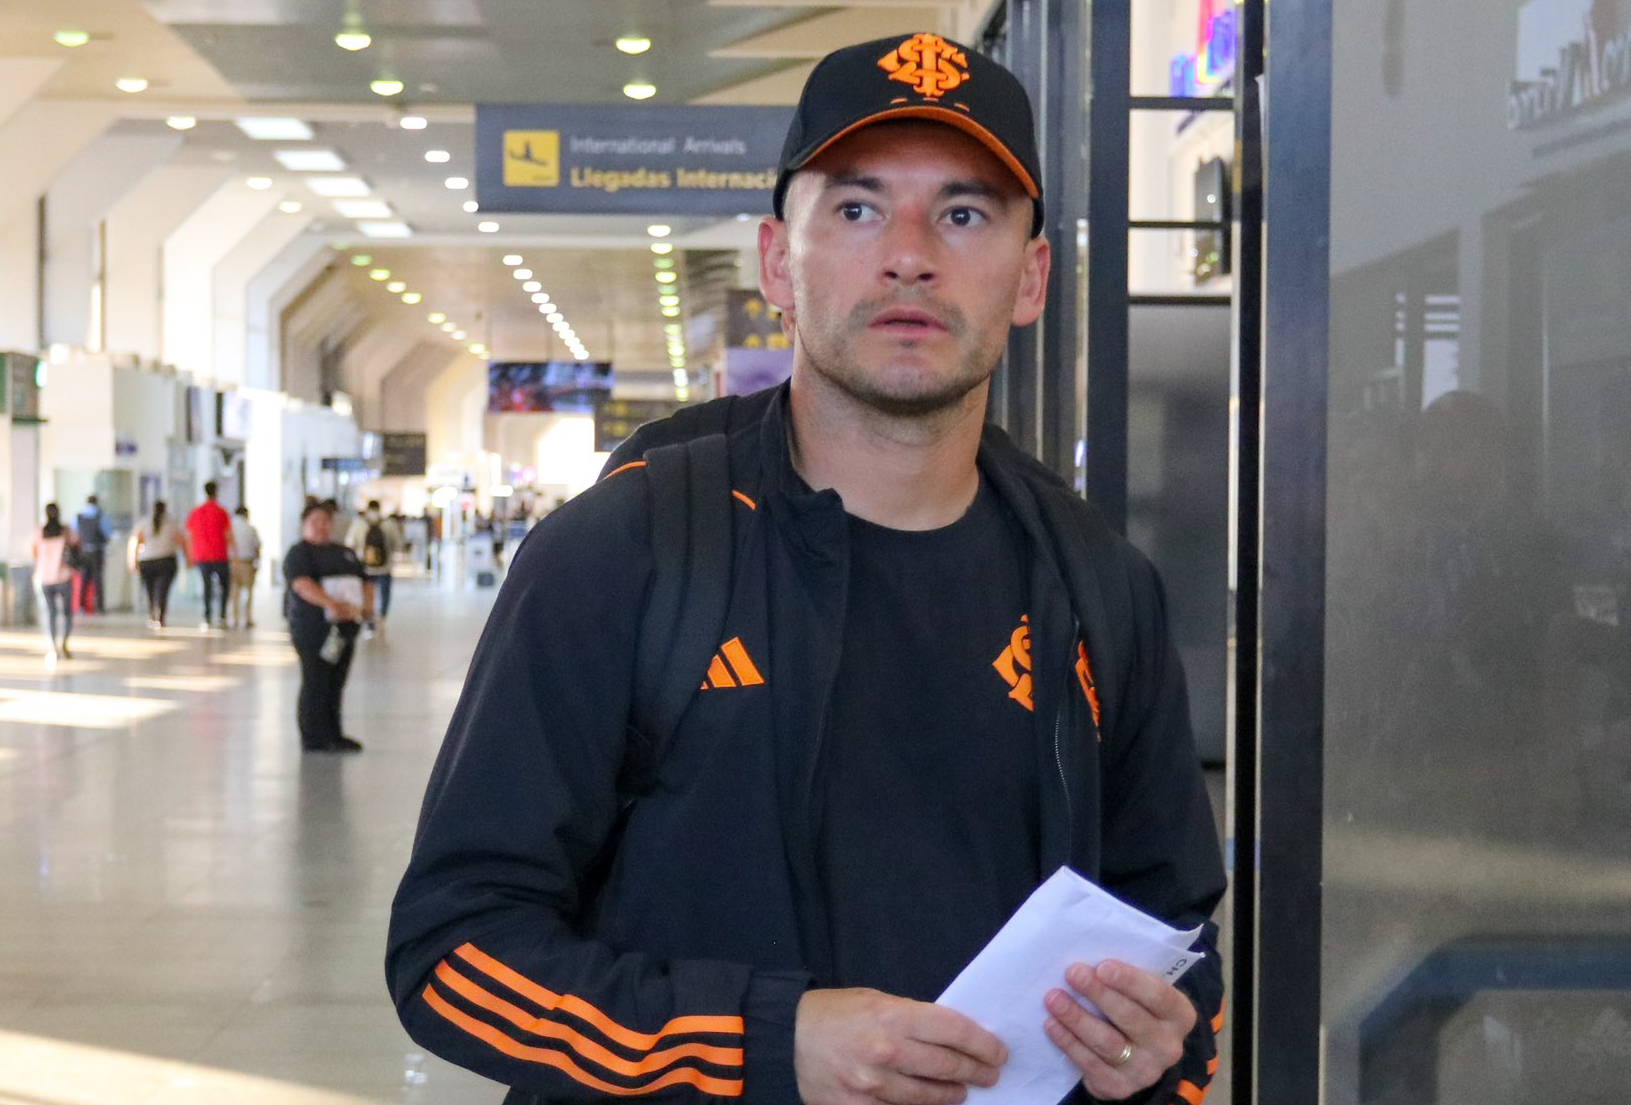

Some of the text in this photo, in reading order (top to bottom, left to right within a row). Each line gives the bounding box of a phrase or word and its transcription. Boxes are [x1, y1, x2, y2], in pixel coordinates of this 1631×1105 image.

[571, 136, 747, 154] International Arrivals
[571, 167, 778, 192] Llegadas Internaci
[1163, 958, 1188, 977] CH
